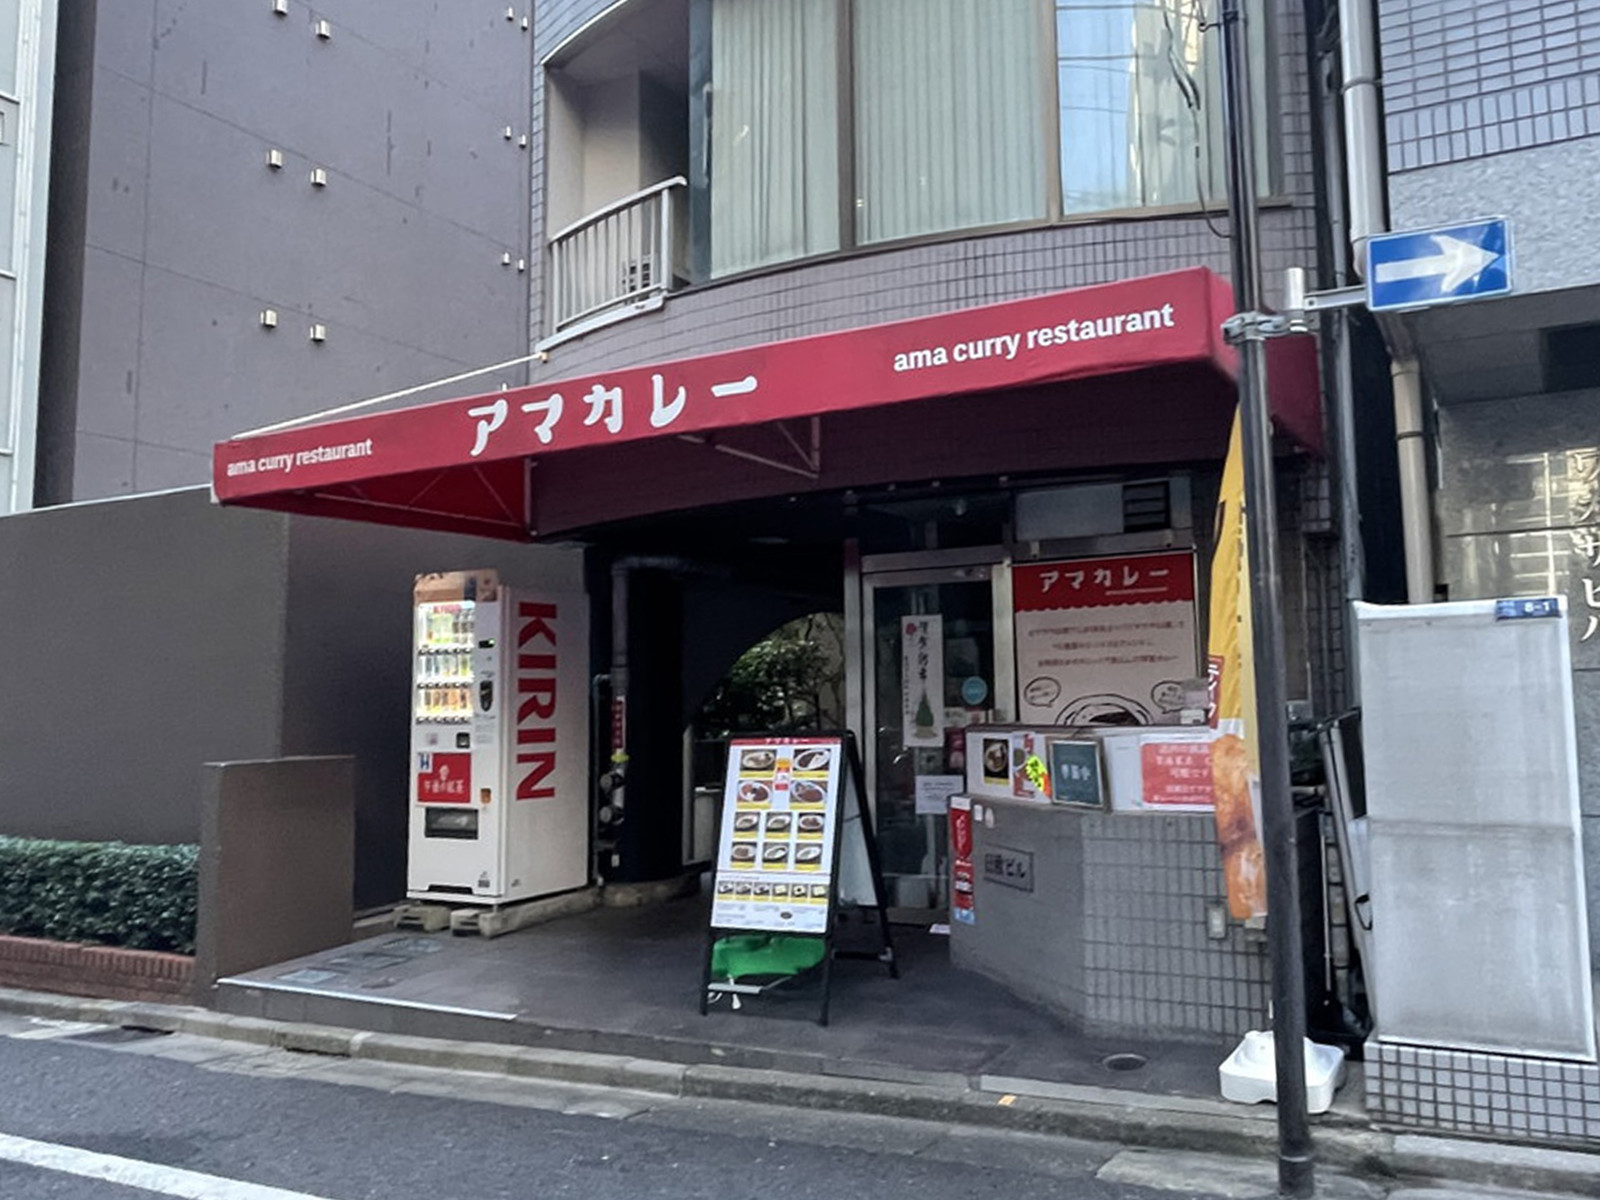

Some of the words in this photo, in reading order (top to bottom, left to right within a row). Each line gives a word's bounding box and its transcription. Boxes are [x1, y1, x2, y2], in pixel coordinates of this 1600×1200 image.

[893, 346, 948, 372] ama
[952, 332, 1020, 361] curry
[1026, 302, 1175, 350] restaurant
[469, 373, 758, 457] アマカレー
[227, 457, 256, 477] ama
[257, 454, 293, 473] curry
[295, 437, 373, 466] restaurant
[1039, 565, 1170, 593] アマカレー
[515, 601, 557, 801] KIRIN
